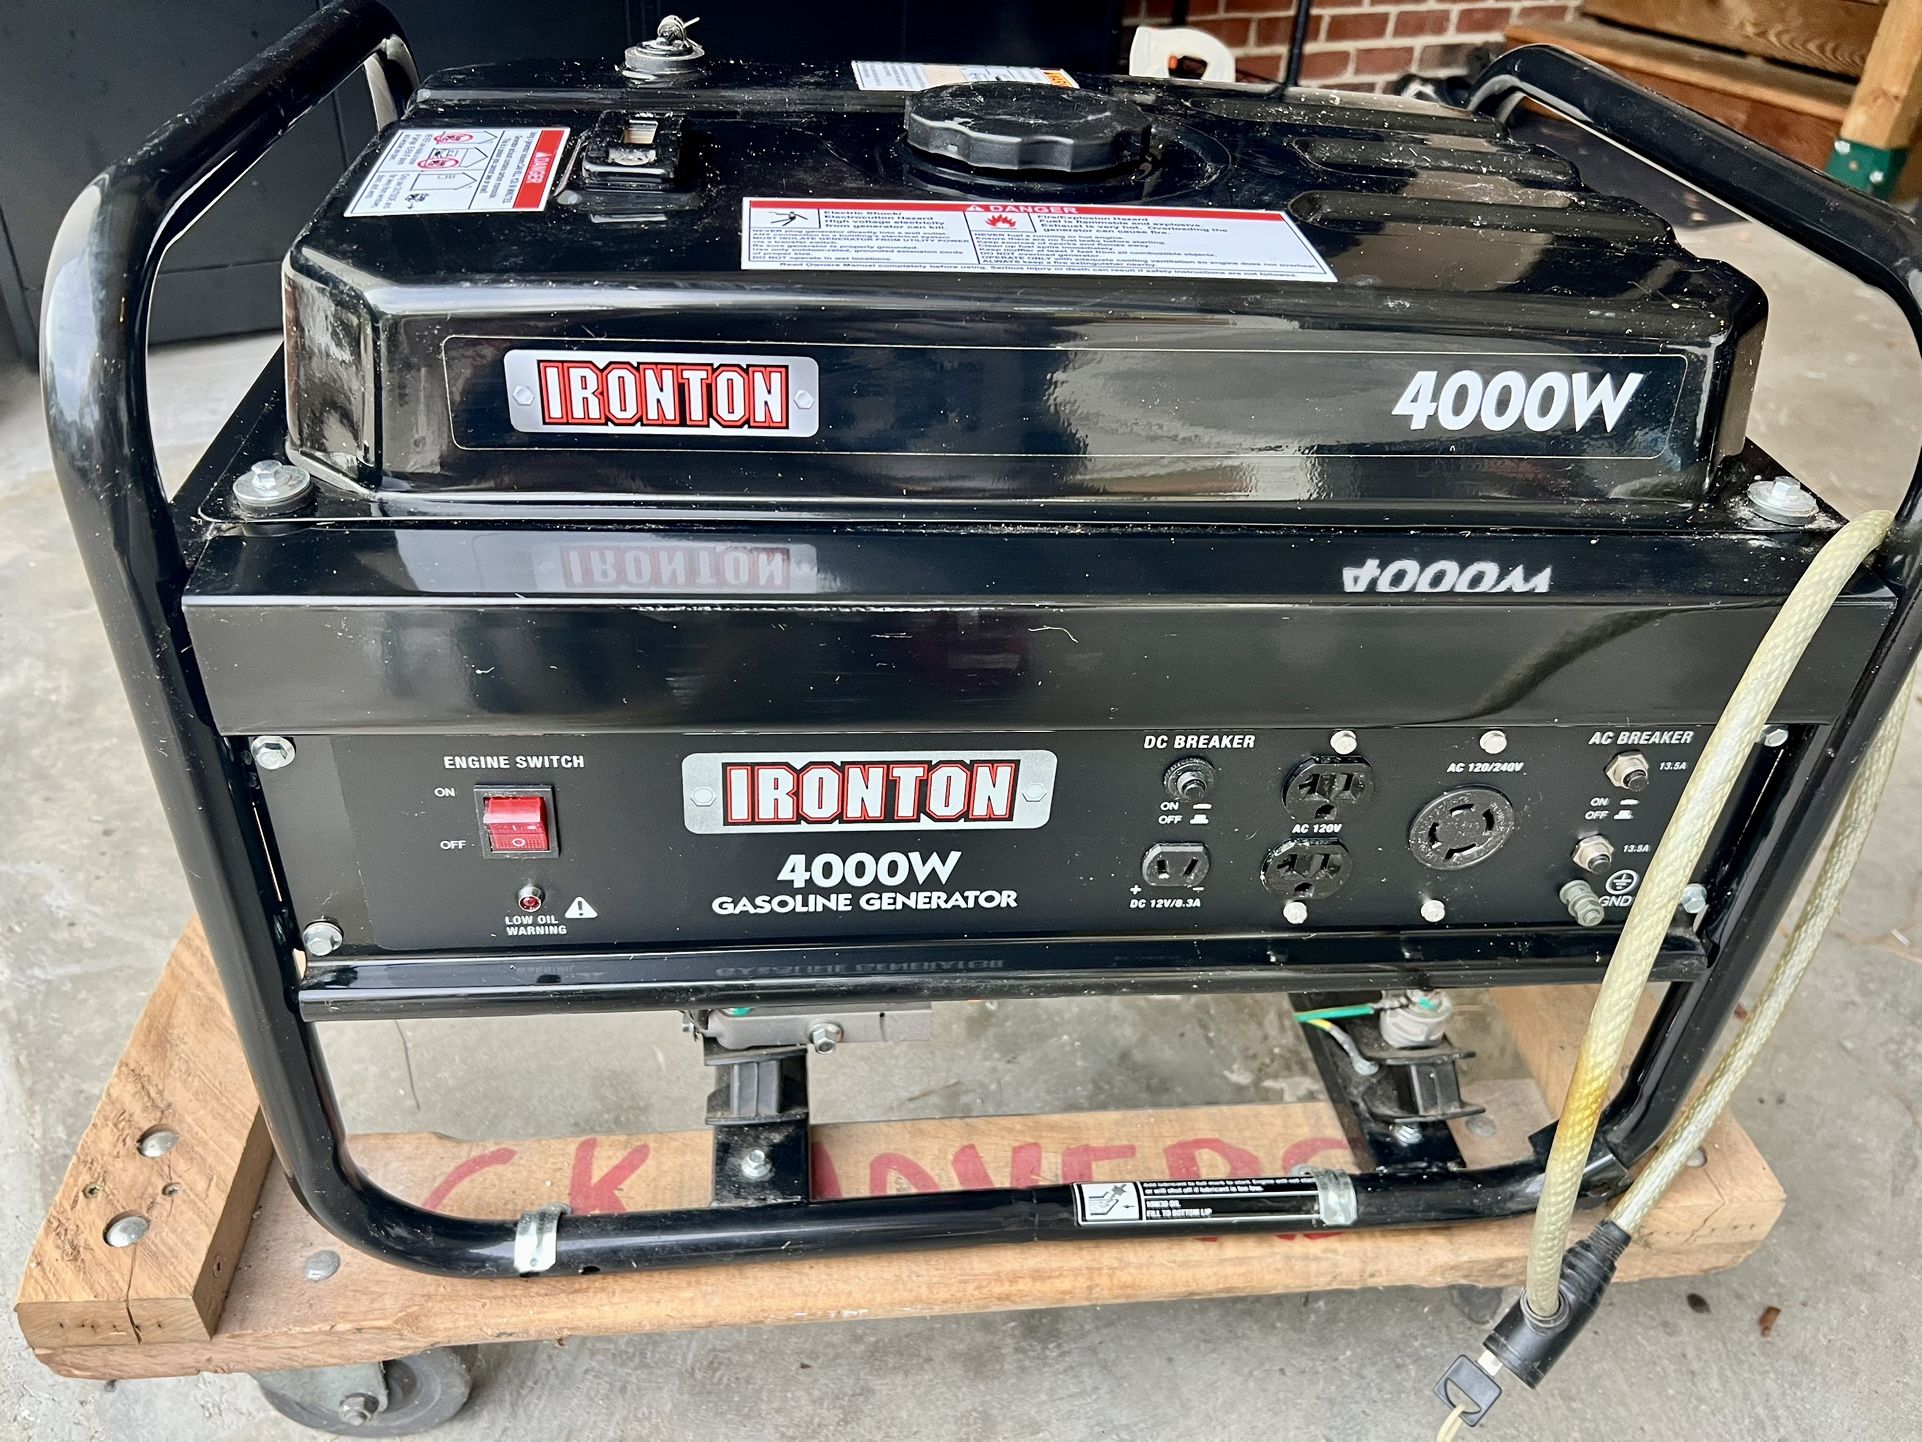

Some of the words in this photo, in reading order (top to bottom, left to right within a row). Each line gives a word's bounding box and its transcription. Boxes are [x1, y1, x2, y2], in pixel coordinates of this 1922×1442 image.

[989, 205, 1079, 214] DANGER
[538, 361, 789, 429] IRONTON
[1391, 370, 1645, 433] 4000W
[1143, 735, 1168, 749] DC
[1174, 735, 1256, 749] BREAKER
[1588, 731, 1614, 745] AC
[1617, 731, 1694, 744] BREAKER
[443, 756, 511, 769] ENGINE
[515, 755, 585, 769] SWITCH
[1447, 763, 1466, 773] AC
[1467, 762, 1525, 773] 120/240V
[1659, 761, 1687, 770] 13.5A
[434, 787, 456, 797] ON
[722, 760, 1021, 826] IRONTON
[1160, 802, 1179, 811] ON
[1590, 798, 1609, 807] ON
[1158, 815, 1183, 825] OFF
[1585, 811, 1609, 820] OFF
[1292, 824, 1309, 834] AC
[1312, 823, 1343, 833] 120V
[440, 840, 467, 850] OFF
[777, 850, 962, 888] 4000W
[711, 893, 852, 915] GASOLINE
[859, 889, 1018, 911] GENERATOR
[1129, 899, 1147, 908] DC
[1149, 898, 1201, 908] 12V/8.3A
[1599, 895, 1633, 907] GND
[505, 915, 534, 925] LOW
[538, 915, 559, 924] OIL
[506, 925, 567, 936] WARNING
